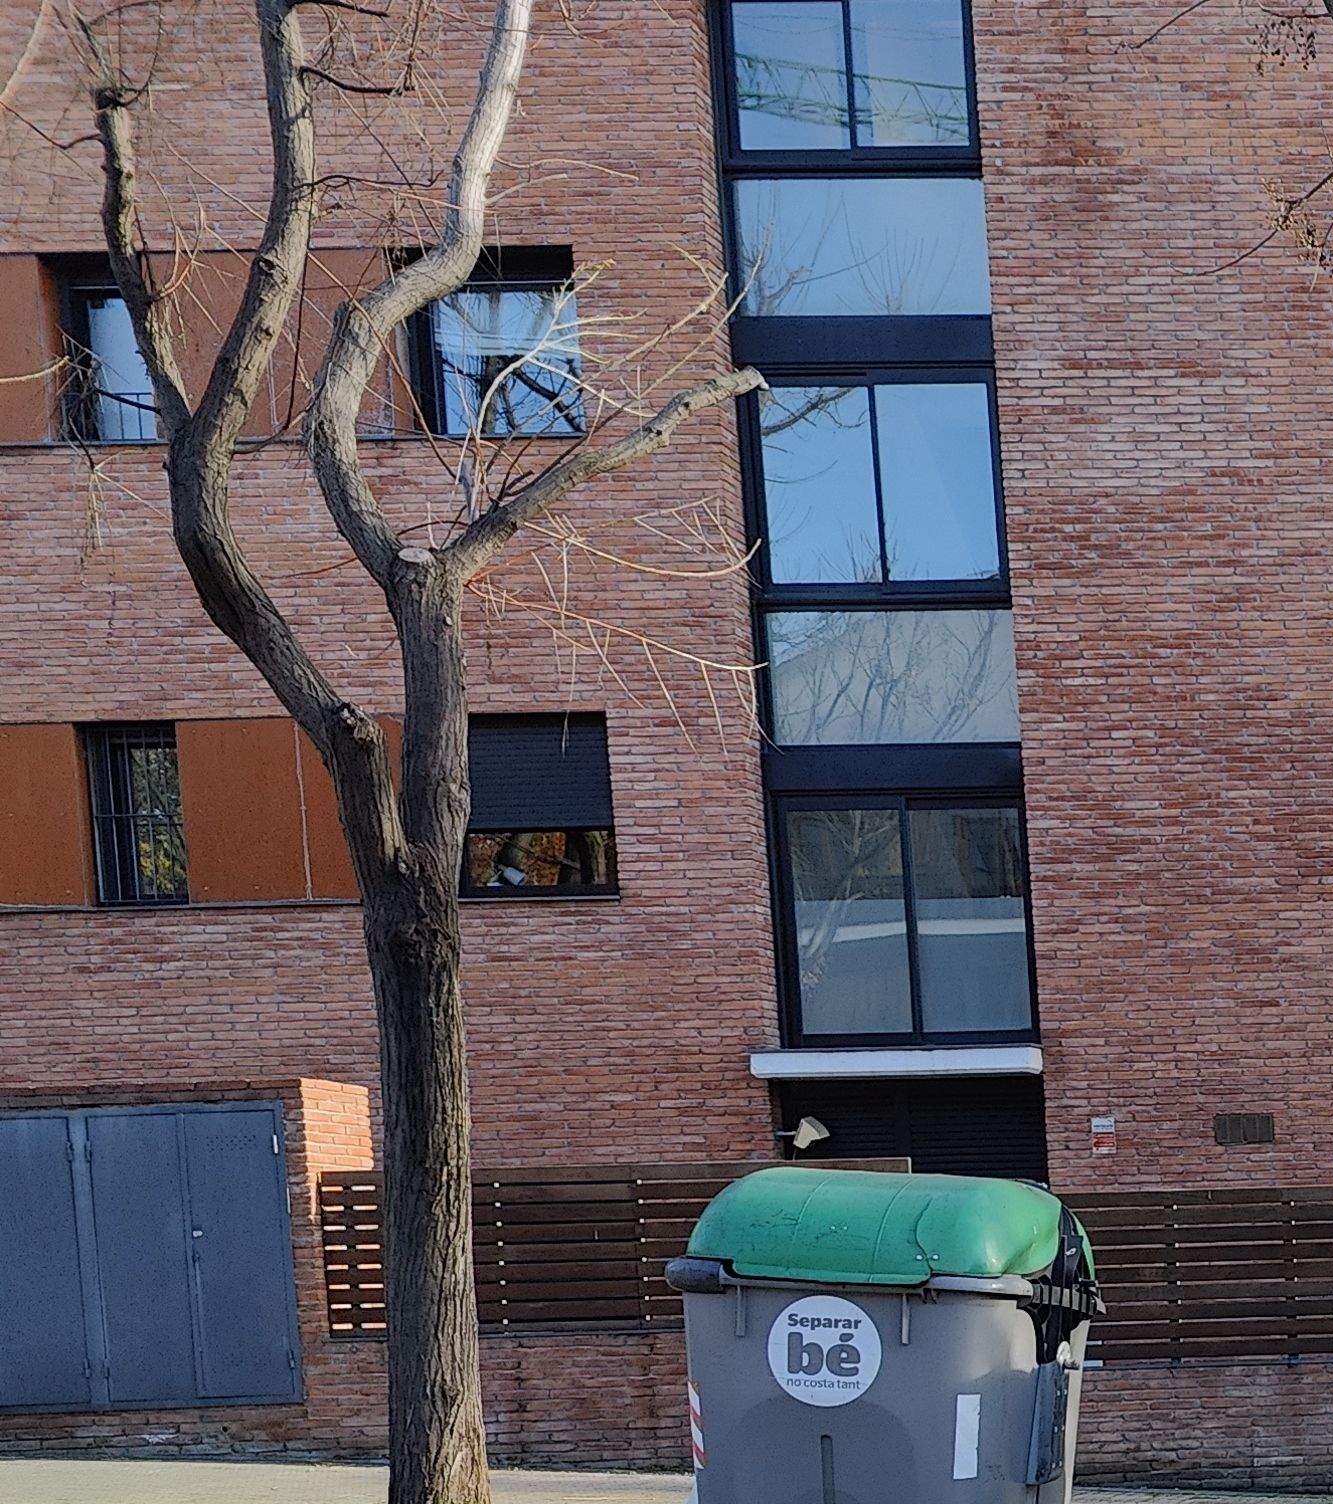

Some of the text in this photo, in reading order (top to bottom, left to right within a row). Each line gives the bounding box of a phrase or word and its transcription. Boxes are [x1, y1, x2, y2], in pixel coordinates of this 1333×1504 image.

[787, 1313, 862, 1331] Separar
[787, 1331, 861, 1378] bé
[786, 1379, 861, 1390] no costa tant
